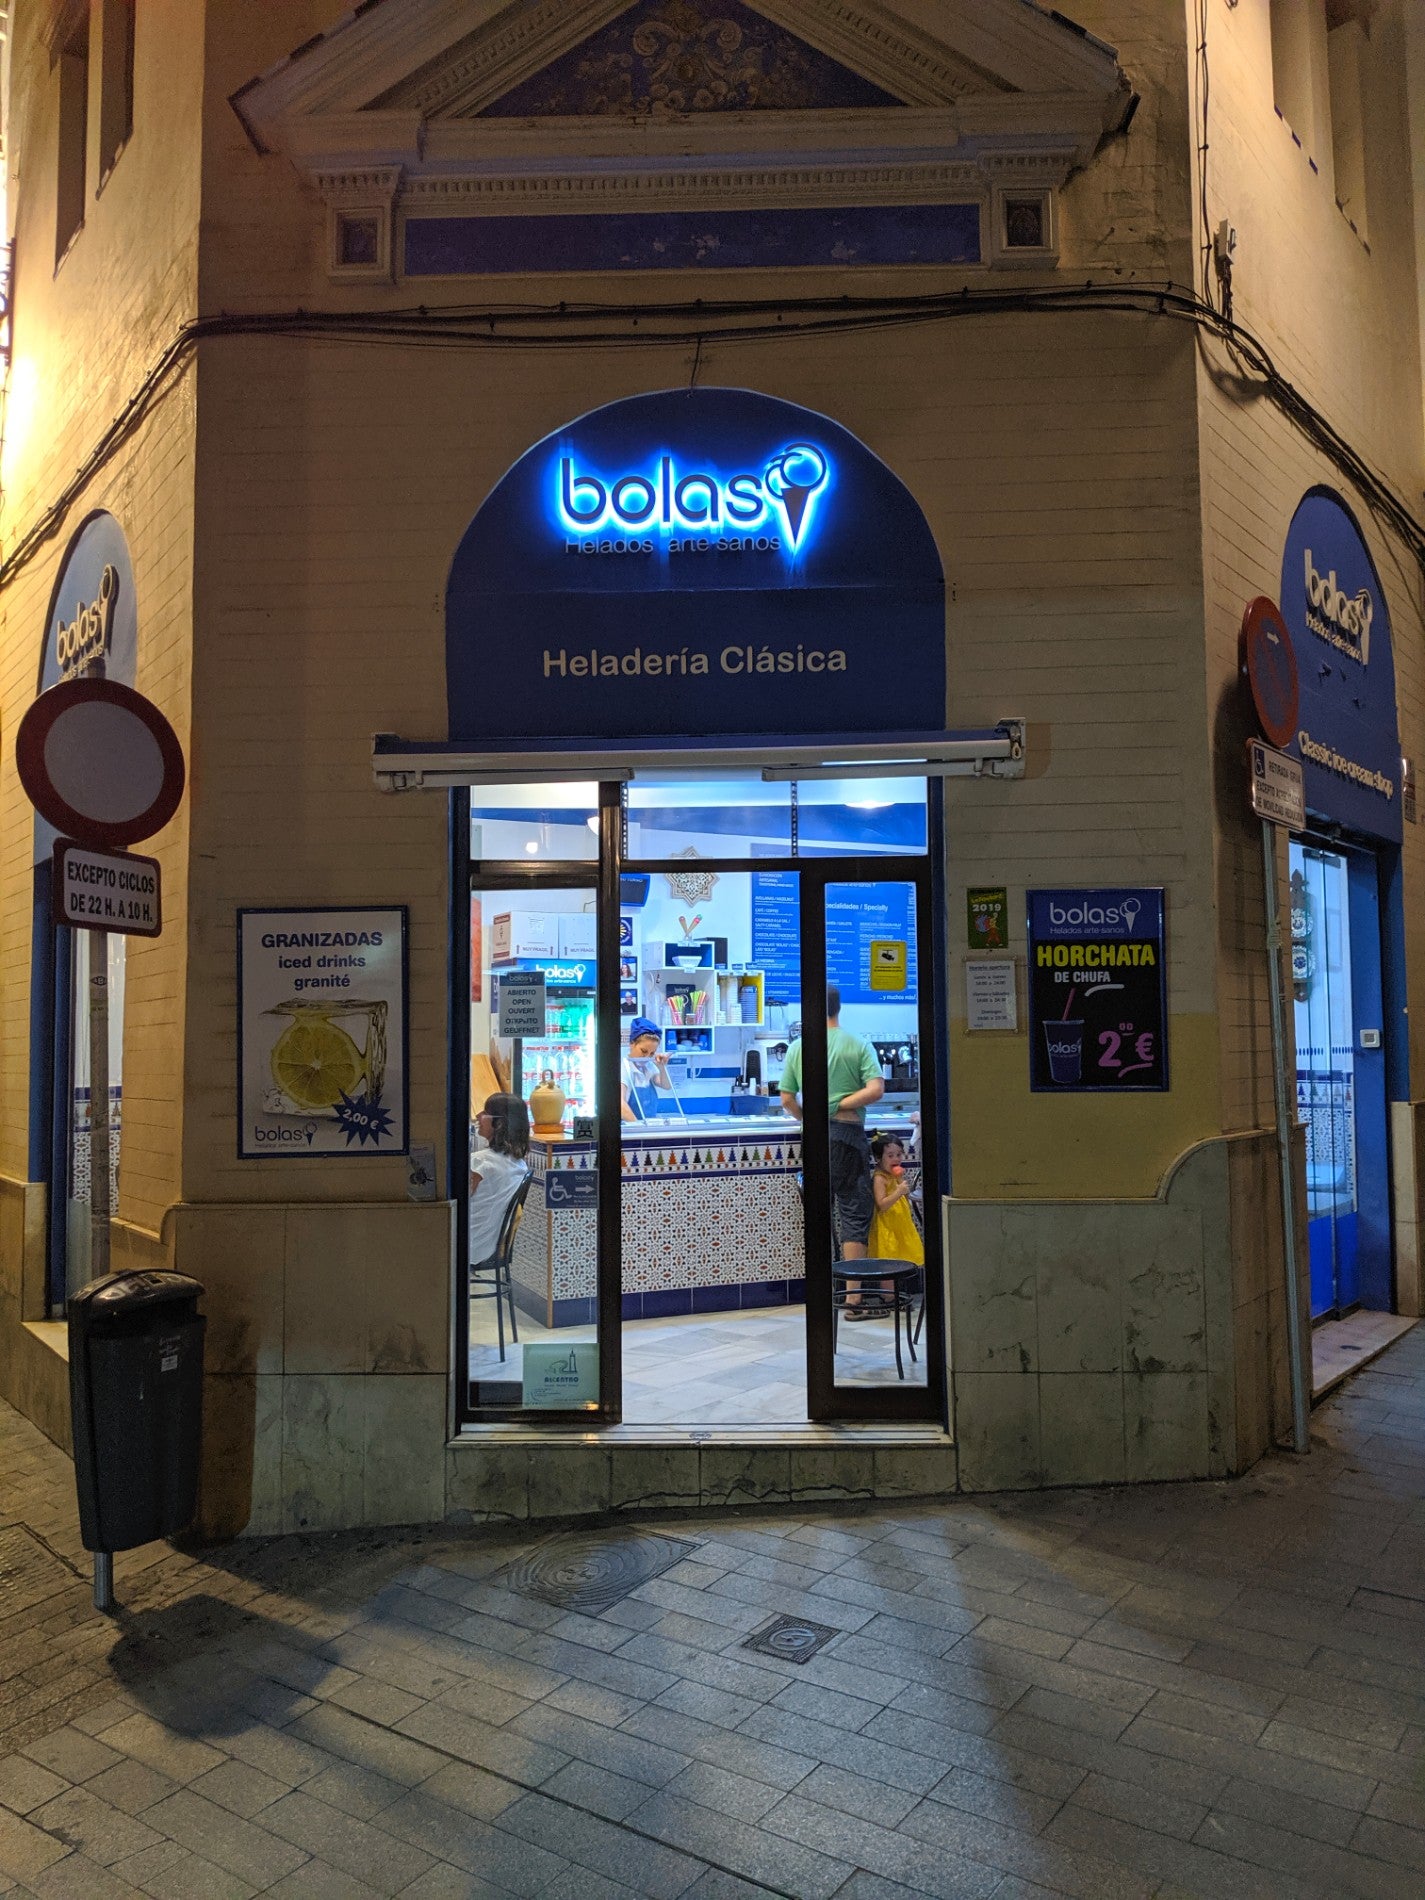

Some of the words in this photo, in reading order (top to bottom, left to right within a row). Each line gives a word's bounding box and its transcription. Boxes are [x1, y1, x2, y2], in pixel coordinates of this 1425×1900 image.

[561, 457, 763, 525] bolas
[565, 537, 653, 554] Helados
[1304, 548, 1359, 635] bolas
[56, 601, 98, 666] bolas
[544, 647, 709, 678] Heladería
[720, 644, 847, 675] Clásica
[1298, 730, 1333, 767] Classic
[1373, 771, 1393, 800] shop
[67, 861, 116, 888] EXCEPTO
[119, 871, 155, 894] CICLOS
[70, 892, 85, 913] DE
[88, 896, 102, 915] 22
[105, 898, 115, 917] H.
[118, 900, 126, 919] A
[128, 901, 140, 920] 10
[143, 904, 153, 922] H.
[972, 903, 1002, 912] 2019
[1049, 901, 1119, 925] bolas
[261, 932, 383, 949] GRANIZADAS
[1050, 926, 1083, 935] Helados
[278, 955, 312, 969] iced
[317, 955, 366, 968] drinks
[1036, 944, 1156, 967] HORCHATA
[294, 974, 351, 991] granité
[1054, 971, 1070, 983] DE
[1072, 971, 1111, 983] CHUFA
[1098, 1030, 1122, 1067] 2
[1135, 1032, 1154, 1061] €
[342, 1108, 369, 1126] 2,00
[370, 1120, 379, 1130] €
[255, 1125, 303, 1142] bolas
